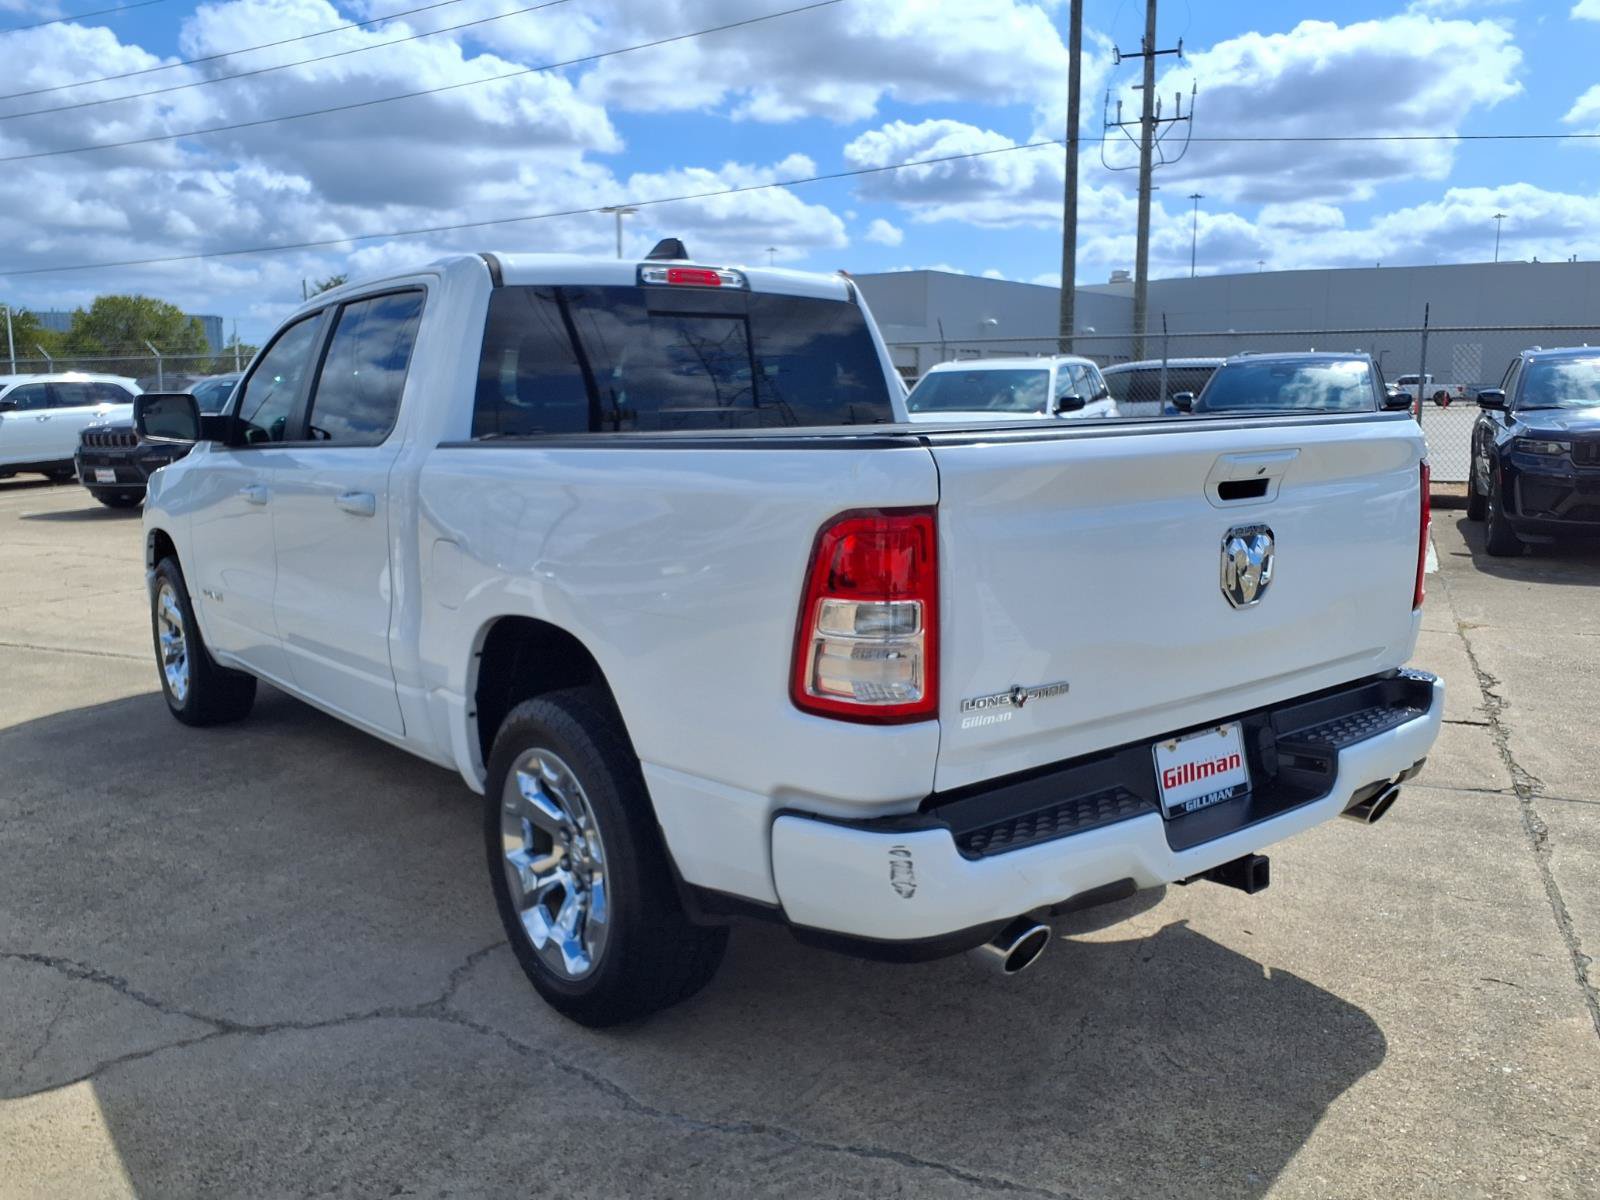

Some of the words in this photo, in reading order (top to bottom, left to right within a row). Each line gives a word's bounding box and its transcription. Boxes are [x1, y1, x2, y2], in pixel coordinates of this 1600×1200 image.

[963, 694, 1010, 712] LONE
[961, 711, 1012, 729] Gillman
[1163, 753, 1240, 790] Gillman
[1186, 788, 1233, 811] GILLMAN
